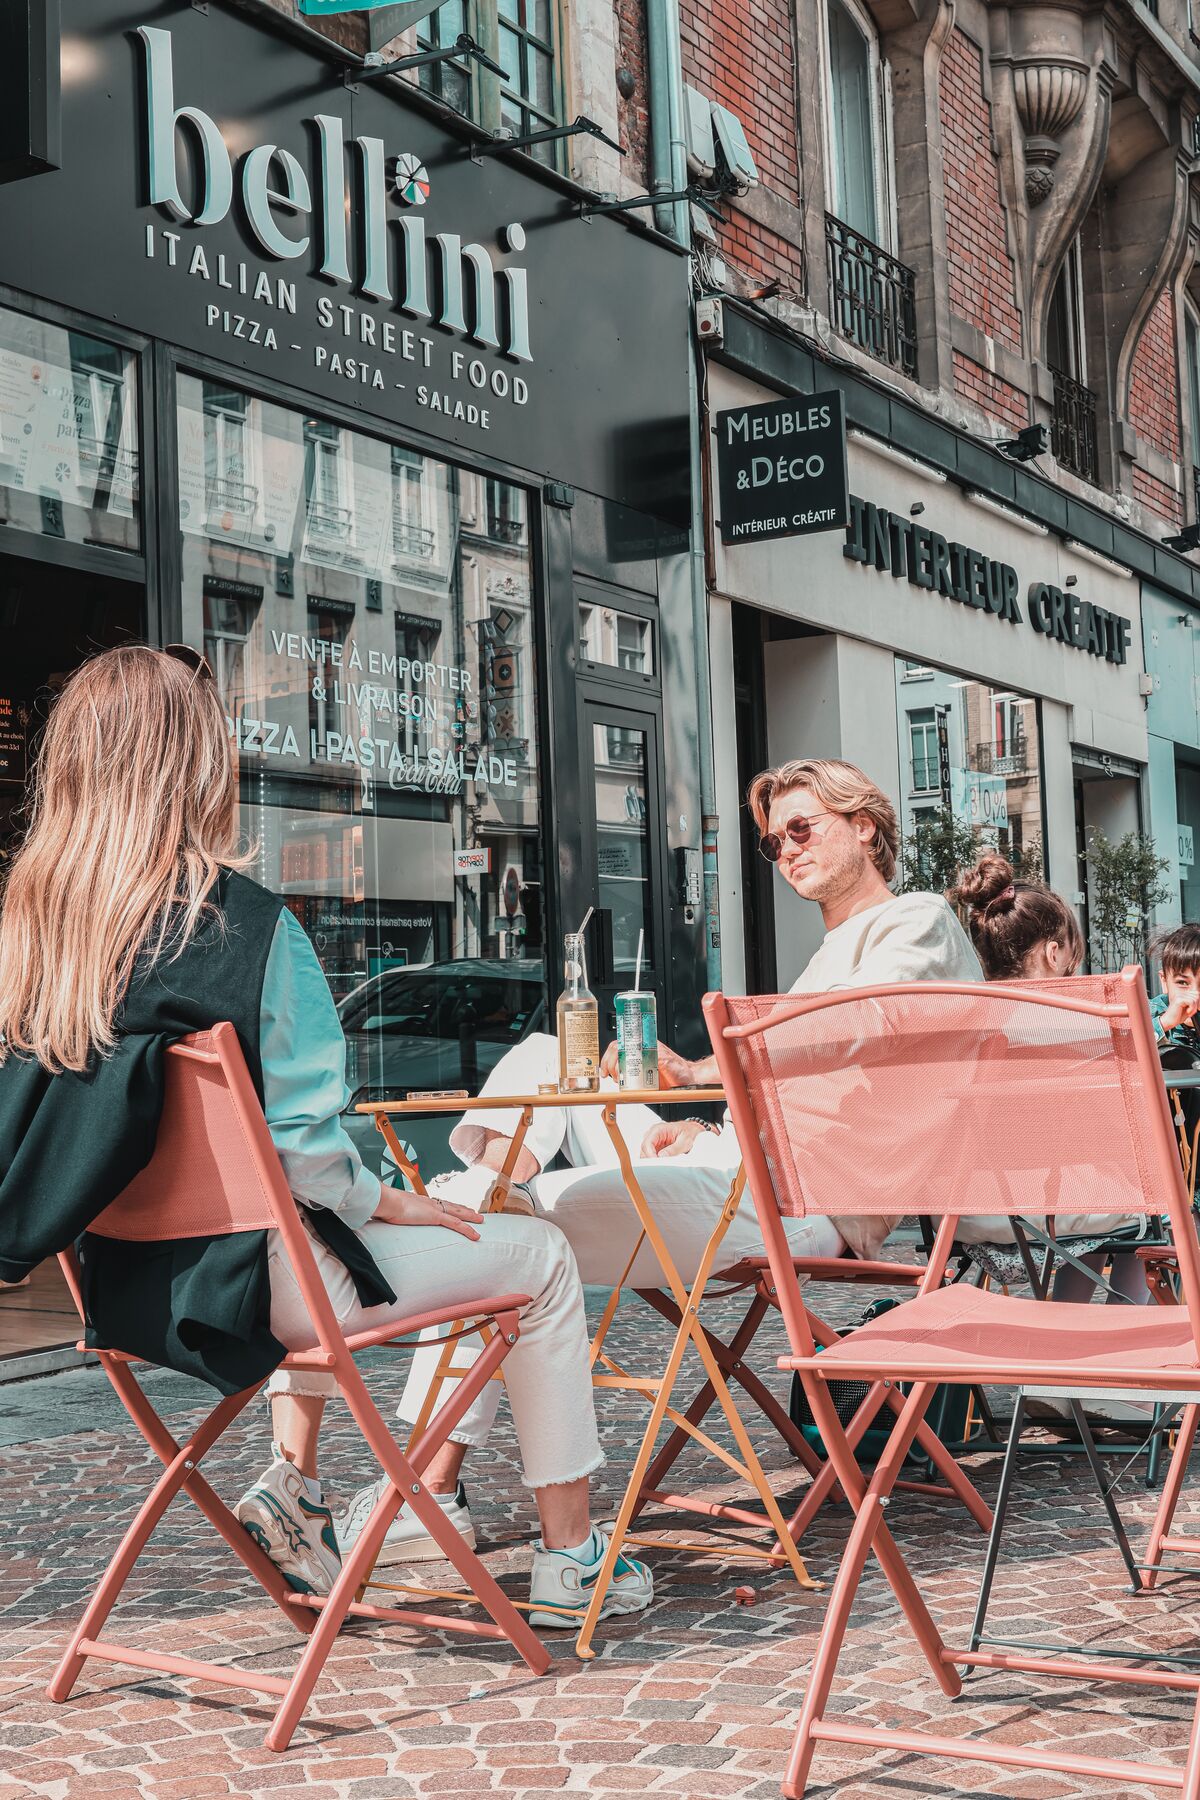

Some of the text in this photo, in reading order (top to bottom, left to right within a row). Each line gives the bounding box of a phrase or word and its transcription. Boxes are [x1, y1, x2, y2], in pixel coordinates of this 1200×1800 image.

[136, 26, 534, 362] bellini
[146, 224, 529, 405] ITALIAN STREET FOOD
[207, 304, 278, 350] PIZZA
[315, 346, 385, 390] PASTA
[417, 385, 490, 430] SALADE
[727, 405, 832, 445] MEUBLES
[732, 508, 836, 536] INTÉRIEUR CRÉATIF
[271, 629, 472, 692] VENTE À EMPORTER
[311, 676, 437, 720] & LIVRAISON
[327, 731, 405, 771] PASTA
[427, 747, 517, 787] SALADE
